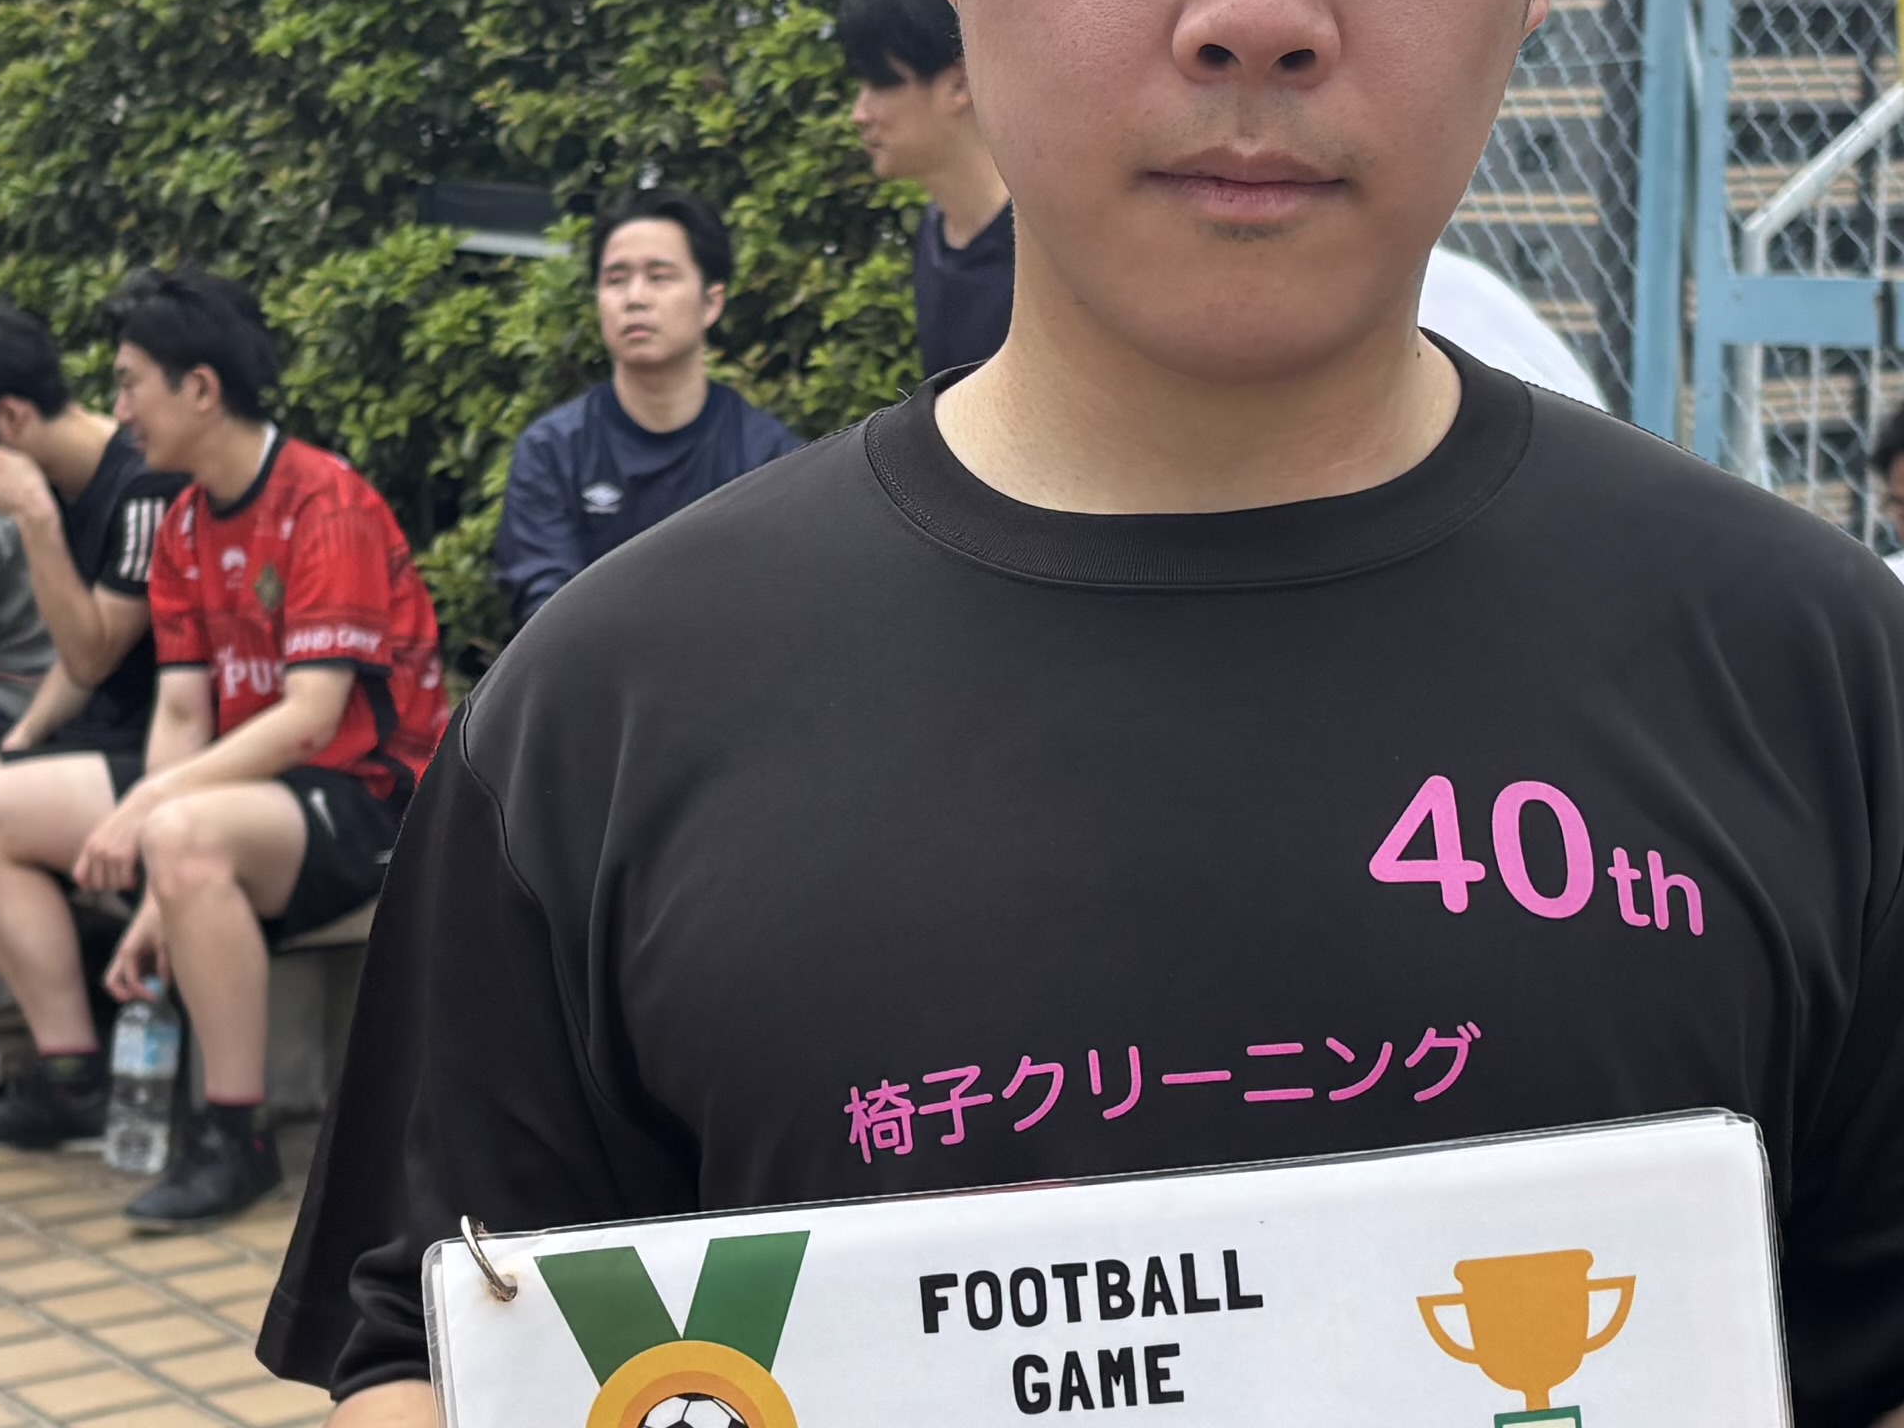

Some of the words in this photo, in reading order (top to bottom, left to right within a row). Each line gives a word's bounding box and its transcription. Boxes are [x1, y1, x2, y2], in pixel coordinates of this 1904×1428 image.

[1370, 776, 1703, 935] 40th
[846, 1024, 1481, 1162] 椅子クリーニング
[920, 1250, 1263, 1333] FOOTBALL
[1013, 1344, 1184, 1414] GAME
